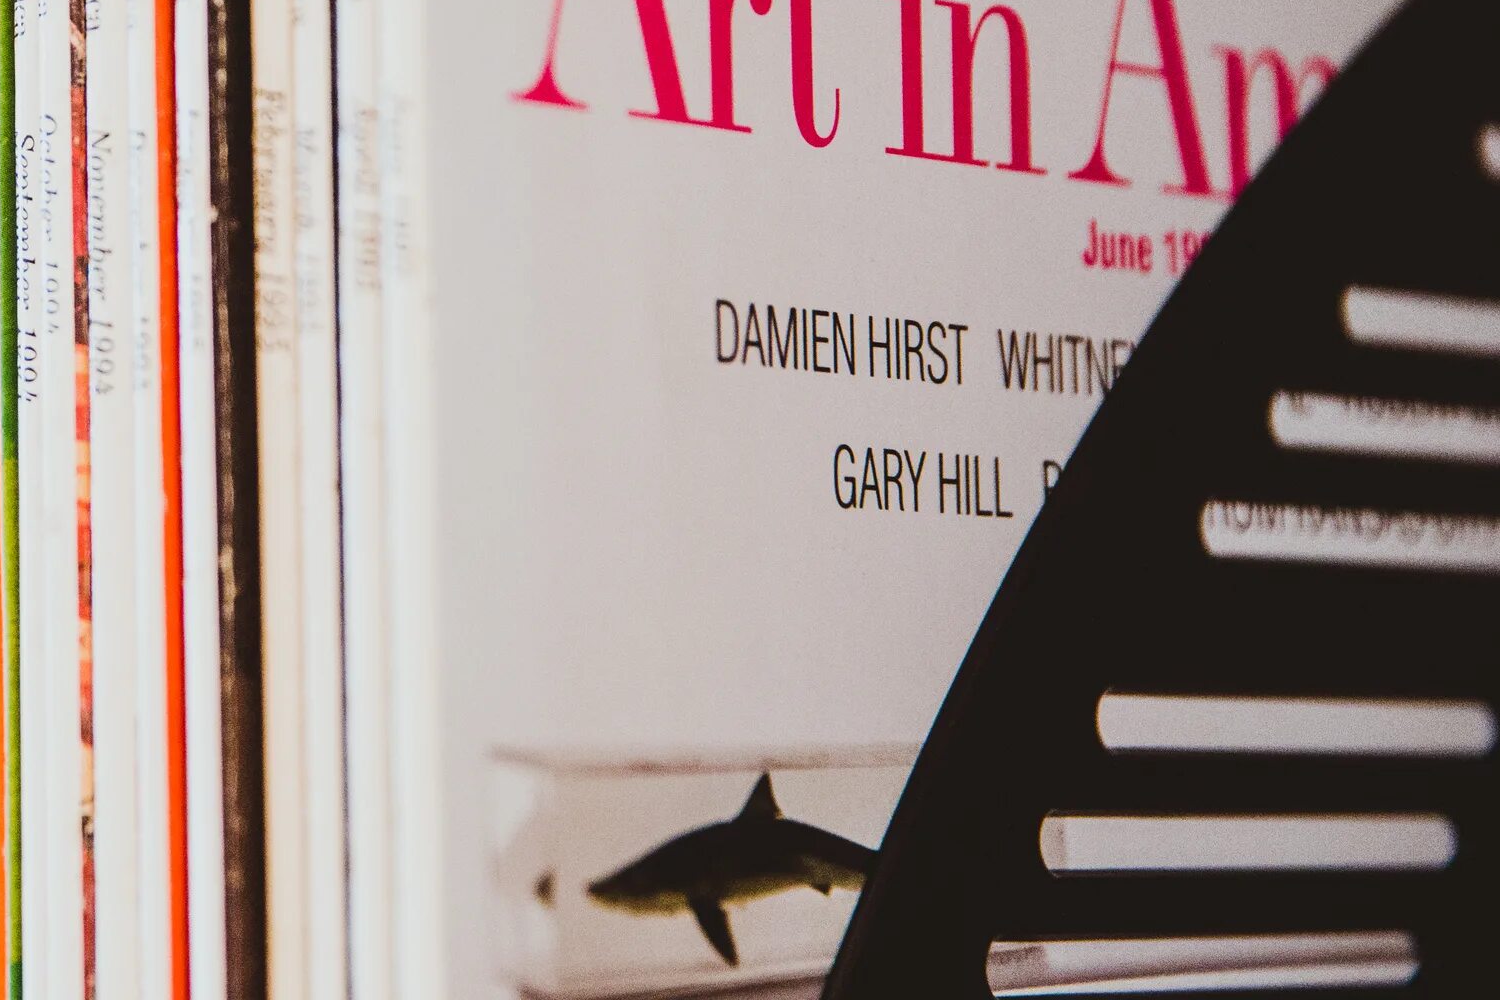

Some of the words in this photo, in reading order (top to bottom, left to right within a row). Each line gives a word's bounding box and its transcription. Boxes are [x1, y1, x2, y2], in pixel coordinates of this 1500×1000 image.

[90, 129, 114, 302] November
[1081, 217, 1152, 276] June
[1162, 226, 1214, 279] 19
[714, 298, 856, 376] DAMIEN
[868, 314, 969, 386] HIRST
[997, 328, 1141, 398] WHITNE
[833, 443, 928, 513] GARY
[938, 451, 1014, 518] HILL
